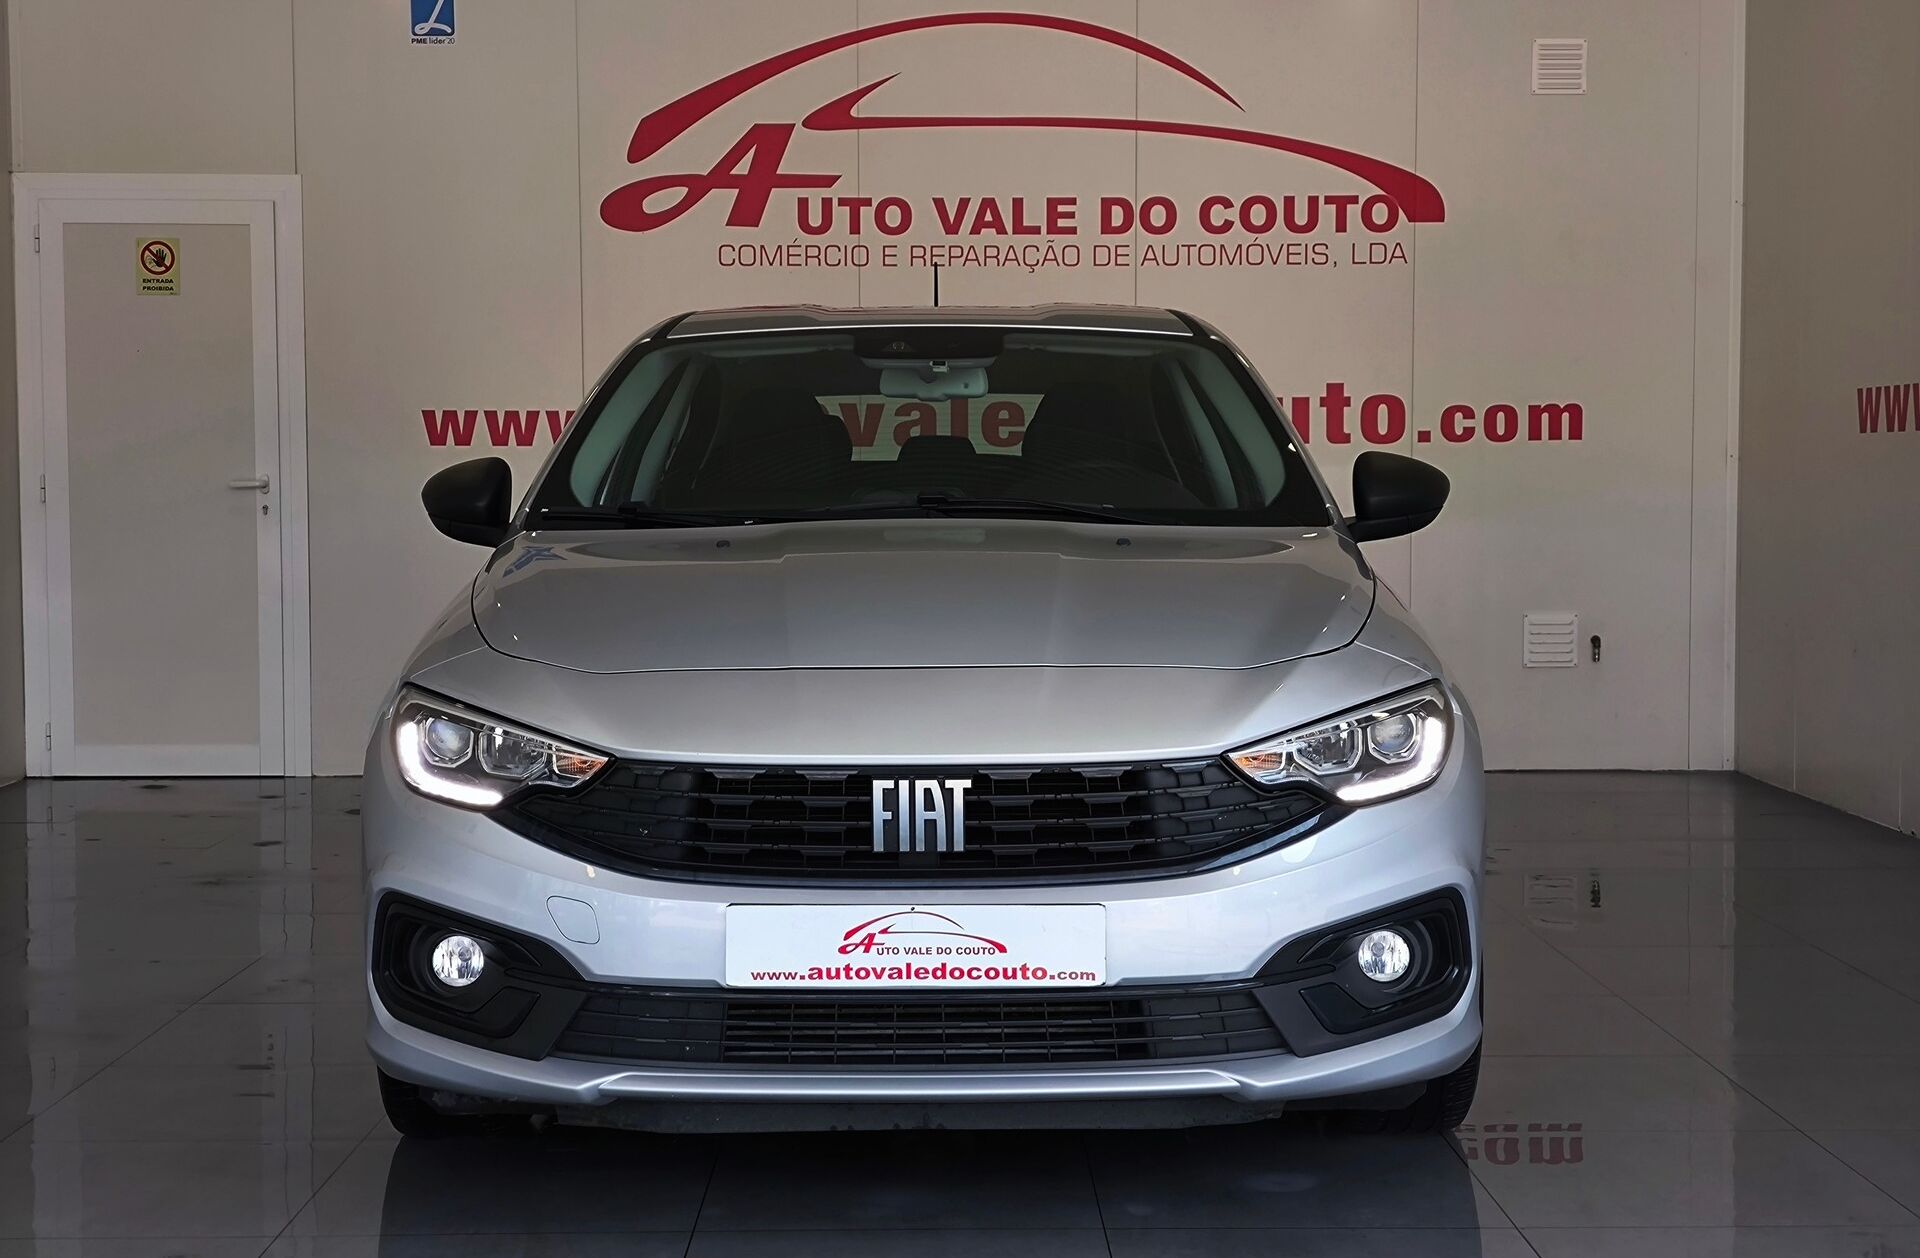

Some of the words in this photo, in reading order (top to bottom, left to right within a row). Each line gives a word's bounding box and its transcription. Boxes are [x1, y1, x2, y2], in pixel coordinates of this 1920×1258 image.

[411, 37, 428, 45] PME
[932, 196, 1079, 236] VALE
[1099, 196, 1178, 236] DO
[1199, 194, 1400, 236] COUTO
[718, 238, 871, 268] COMÉRCIO
[881, 245, 899, 268] E
[909, 239, 1081, 274] REPARAÇÃO
[1092, 244, 1130, 268] DE
[1140, 237, 1339, 268] AUTOMÓVEIS,
[1350, 242, 1409, 266] LDA
[872, 779, 972, 852] FIAT
[904, 946, 933, 956] VALE
[936, 946, 951, 956] DO
[955, 946, 996, 956] COUTO
[751, 962, 1096, 982] www.autovaledocouto.com
